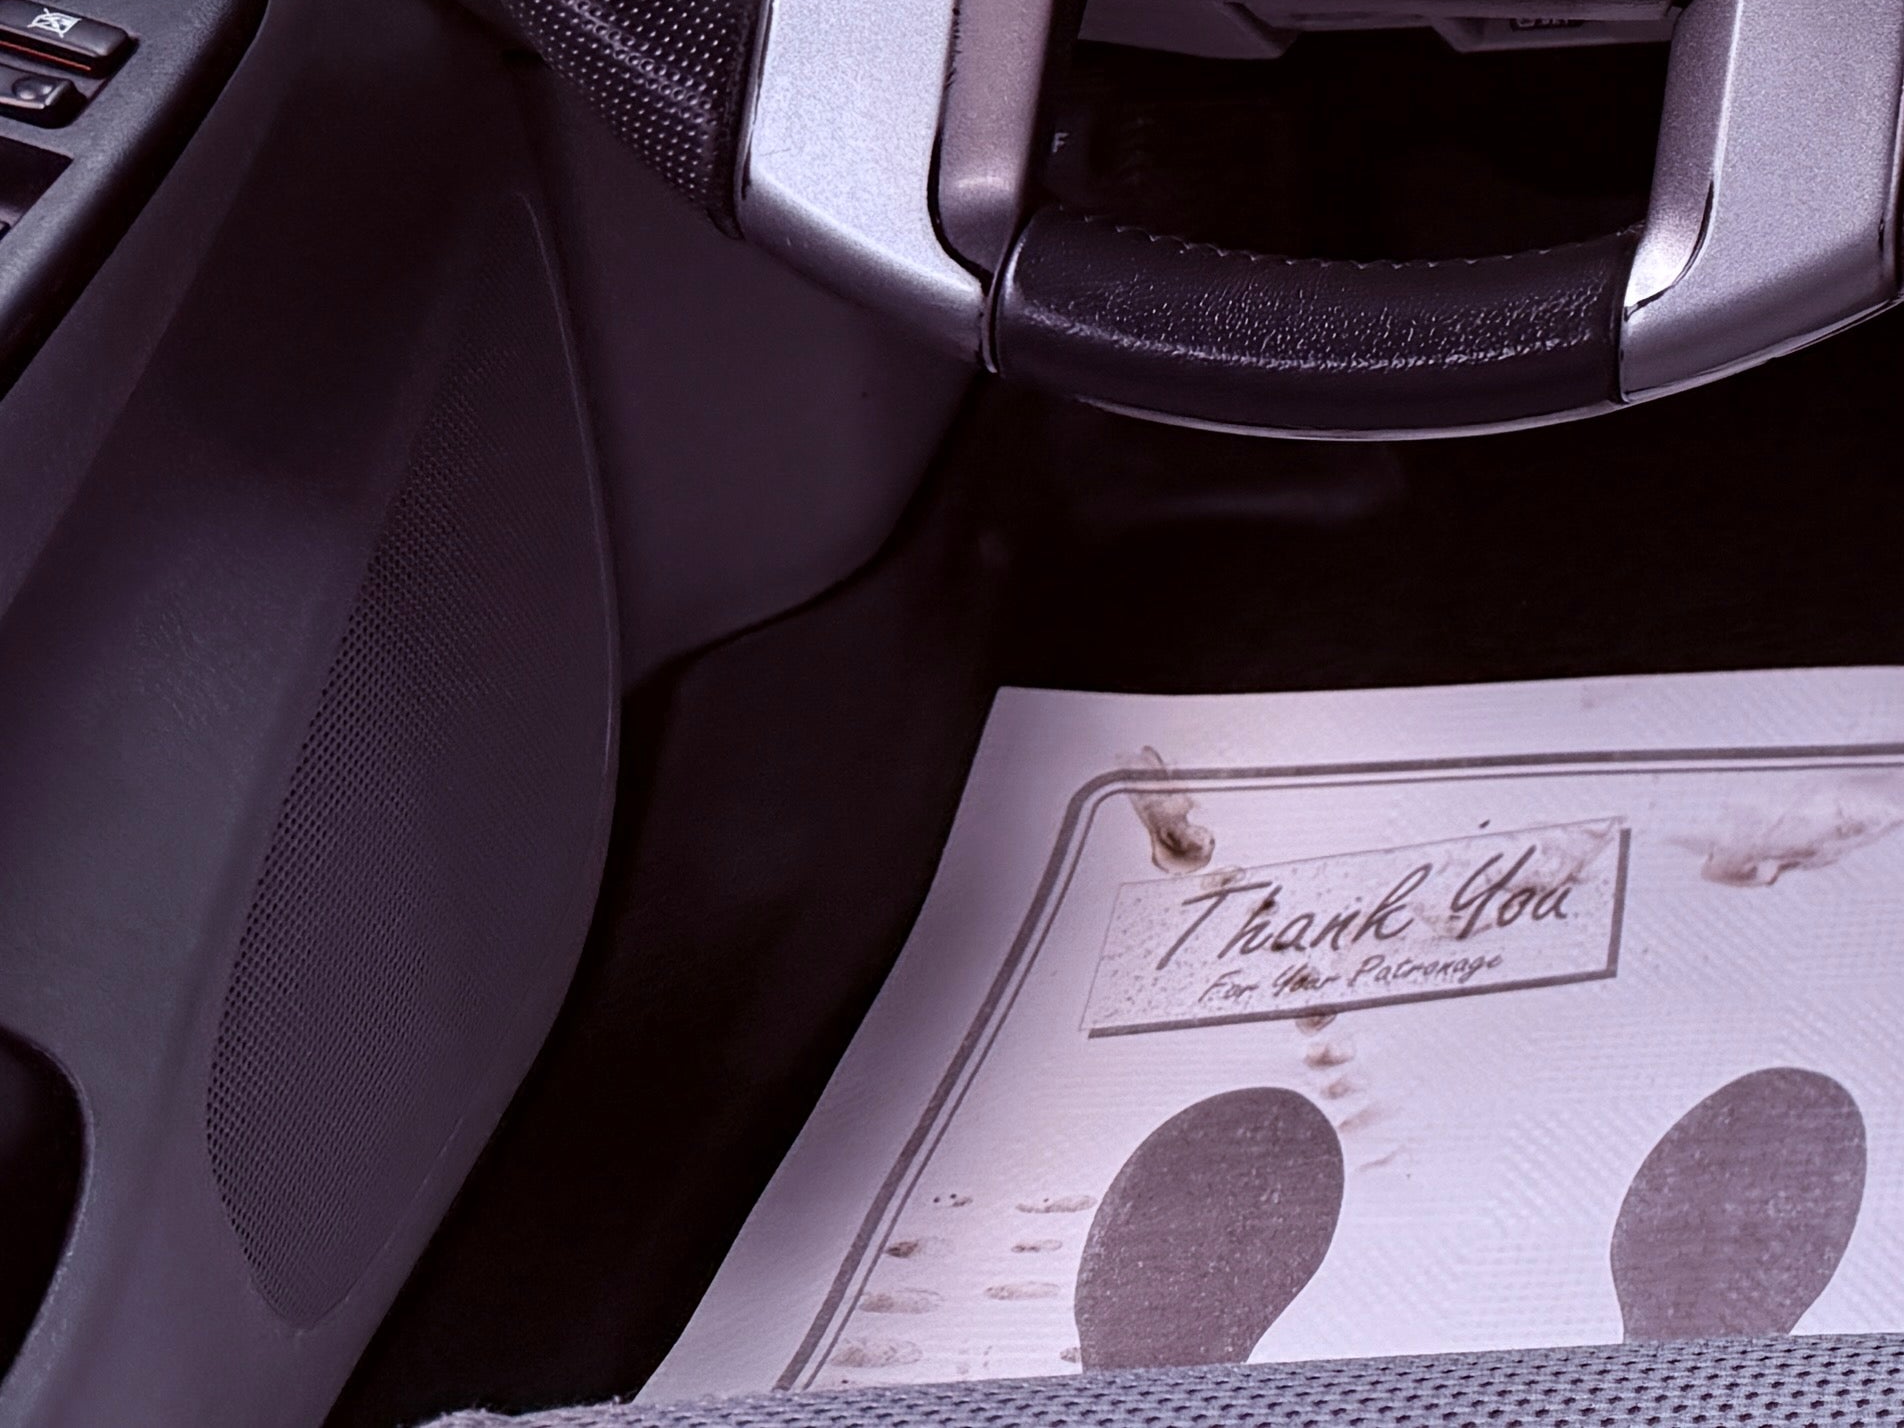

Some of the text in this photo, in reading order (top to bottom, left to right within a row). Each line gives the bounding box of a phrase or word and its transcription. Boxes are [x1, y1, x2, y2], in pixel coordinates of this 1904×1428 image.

[1156, 843, 1578, 971] Thank You
[1197, 952, 1504, 1006] For Your Patronage
